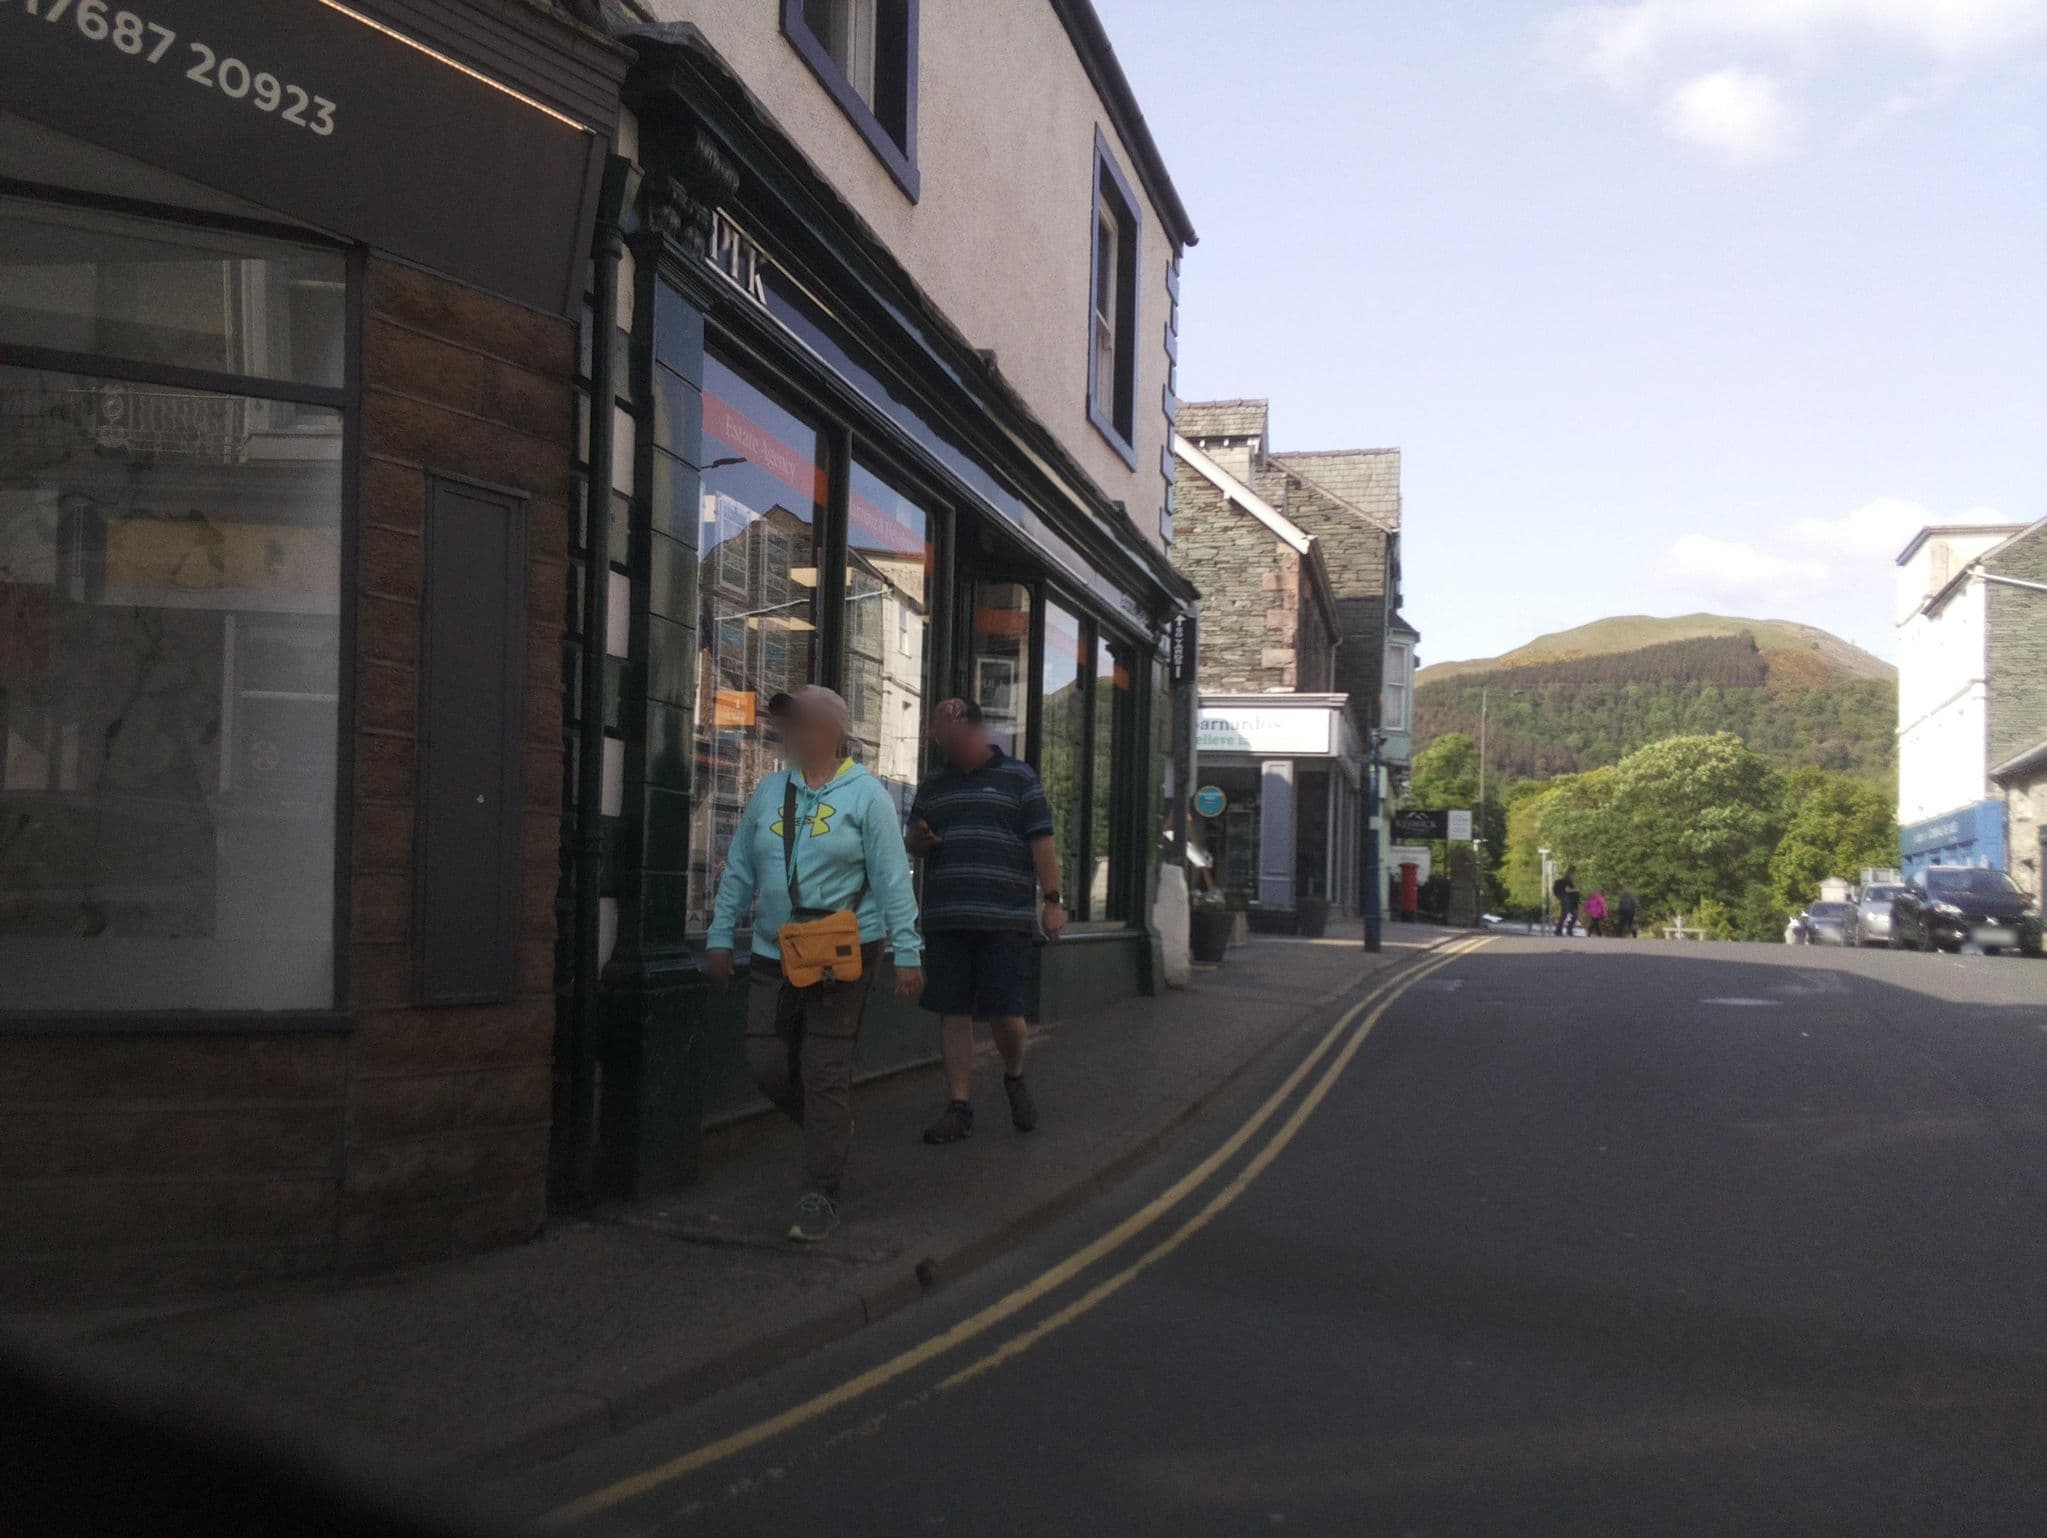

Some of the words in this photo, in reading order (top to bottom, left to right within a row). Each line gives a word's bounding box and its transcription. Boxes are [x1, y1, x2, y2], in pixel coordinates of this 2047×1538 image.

[186, 42, 337, 136] 20923
[725, 413, 758, 455] Estate
[761, 438, 797, 481] Agency
